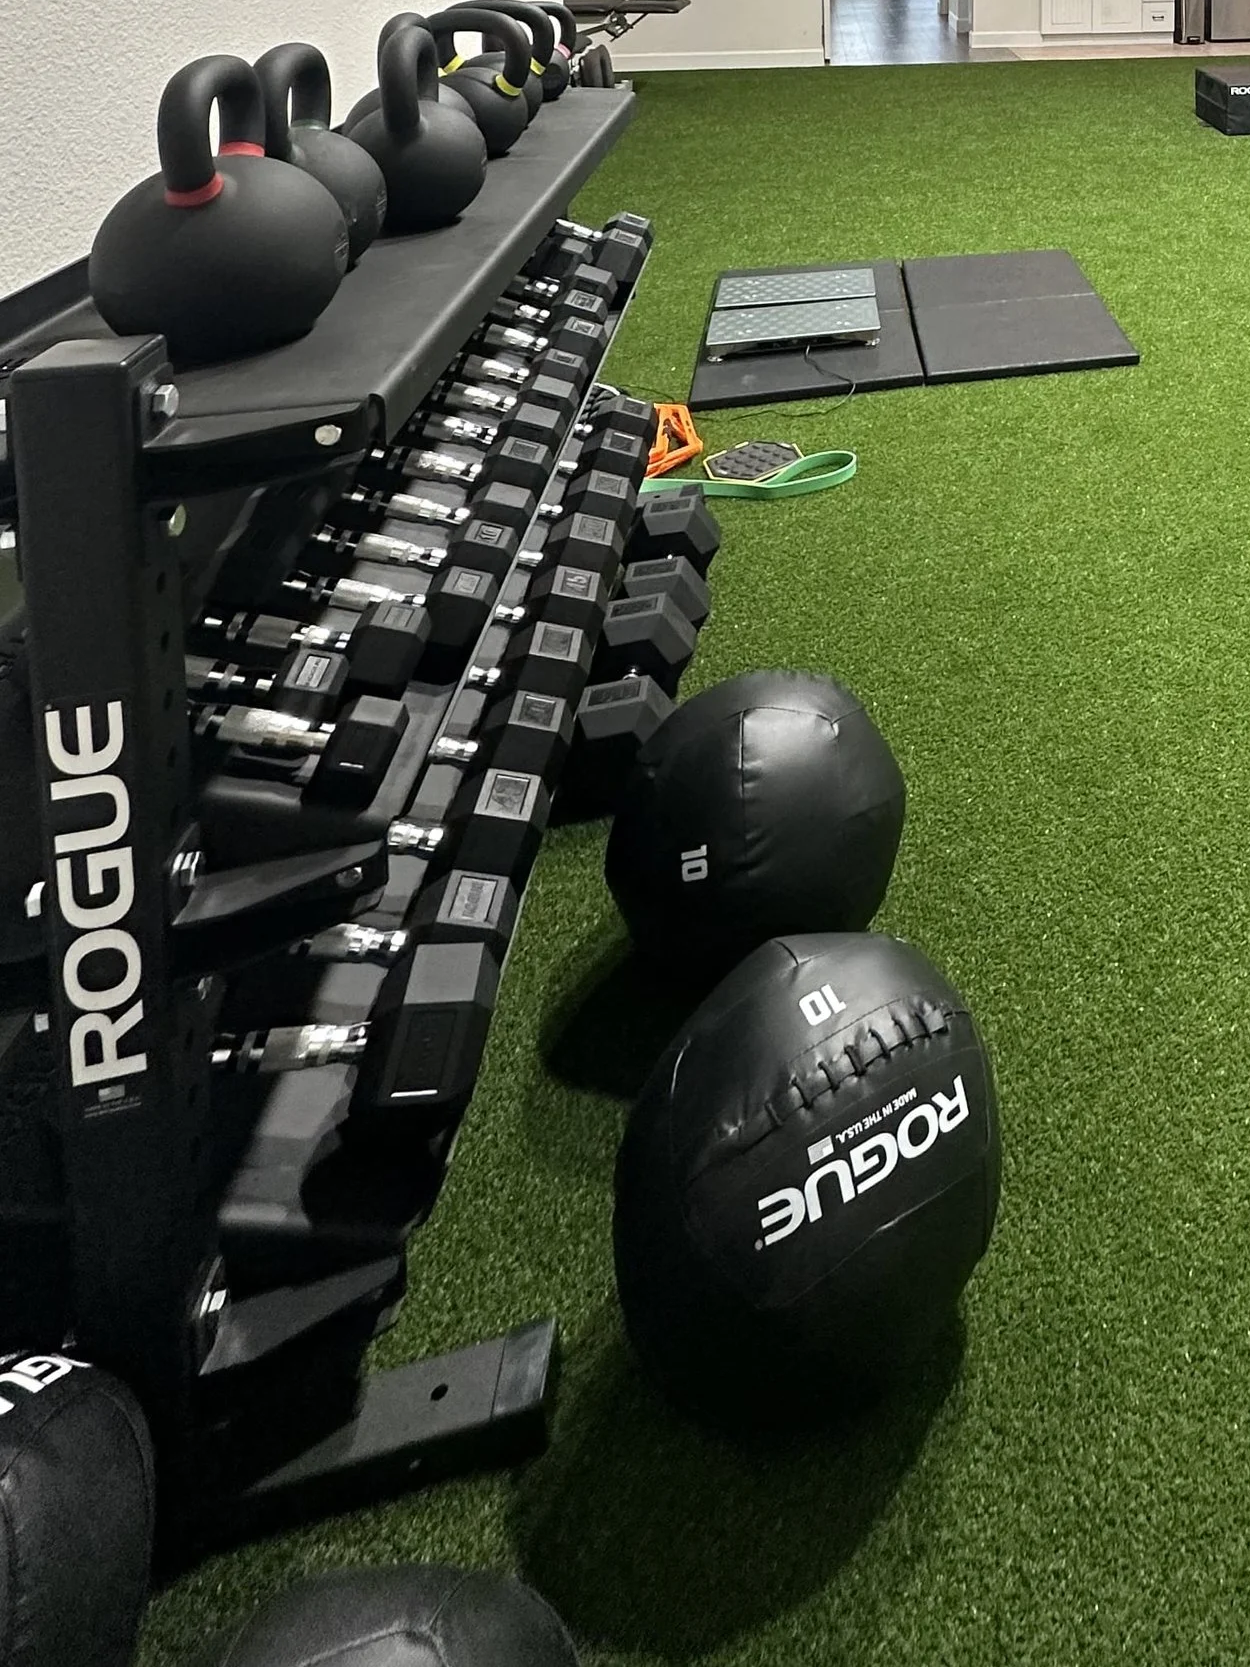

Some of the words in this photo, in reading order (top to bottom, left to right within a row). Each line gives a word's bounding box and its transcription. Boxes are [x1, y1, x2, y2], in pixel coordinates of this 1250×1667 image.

[681, 844, 708, 882] 10
[45, 700, 147, 1087] ROGUE
[799, 984, 847, 1026] 10
[882, 1103, 893, 1117] IN
[892, 1087, 917, 1111] MADE
[835, 1122, 863, 1144] U.S.A.
[862, 1110, 882, 1130] THE
[758, 1075, 969, 1246] ROGUE
